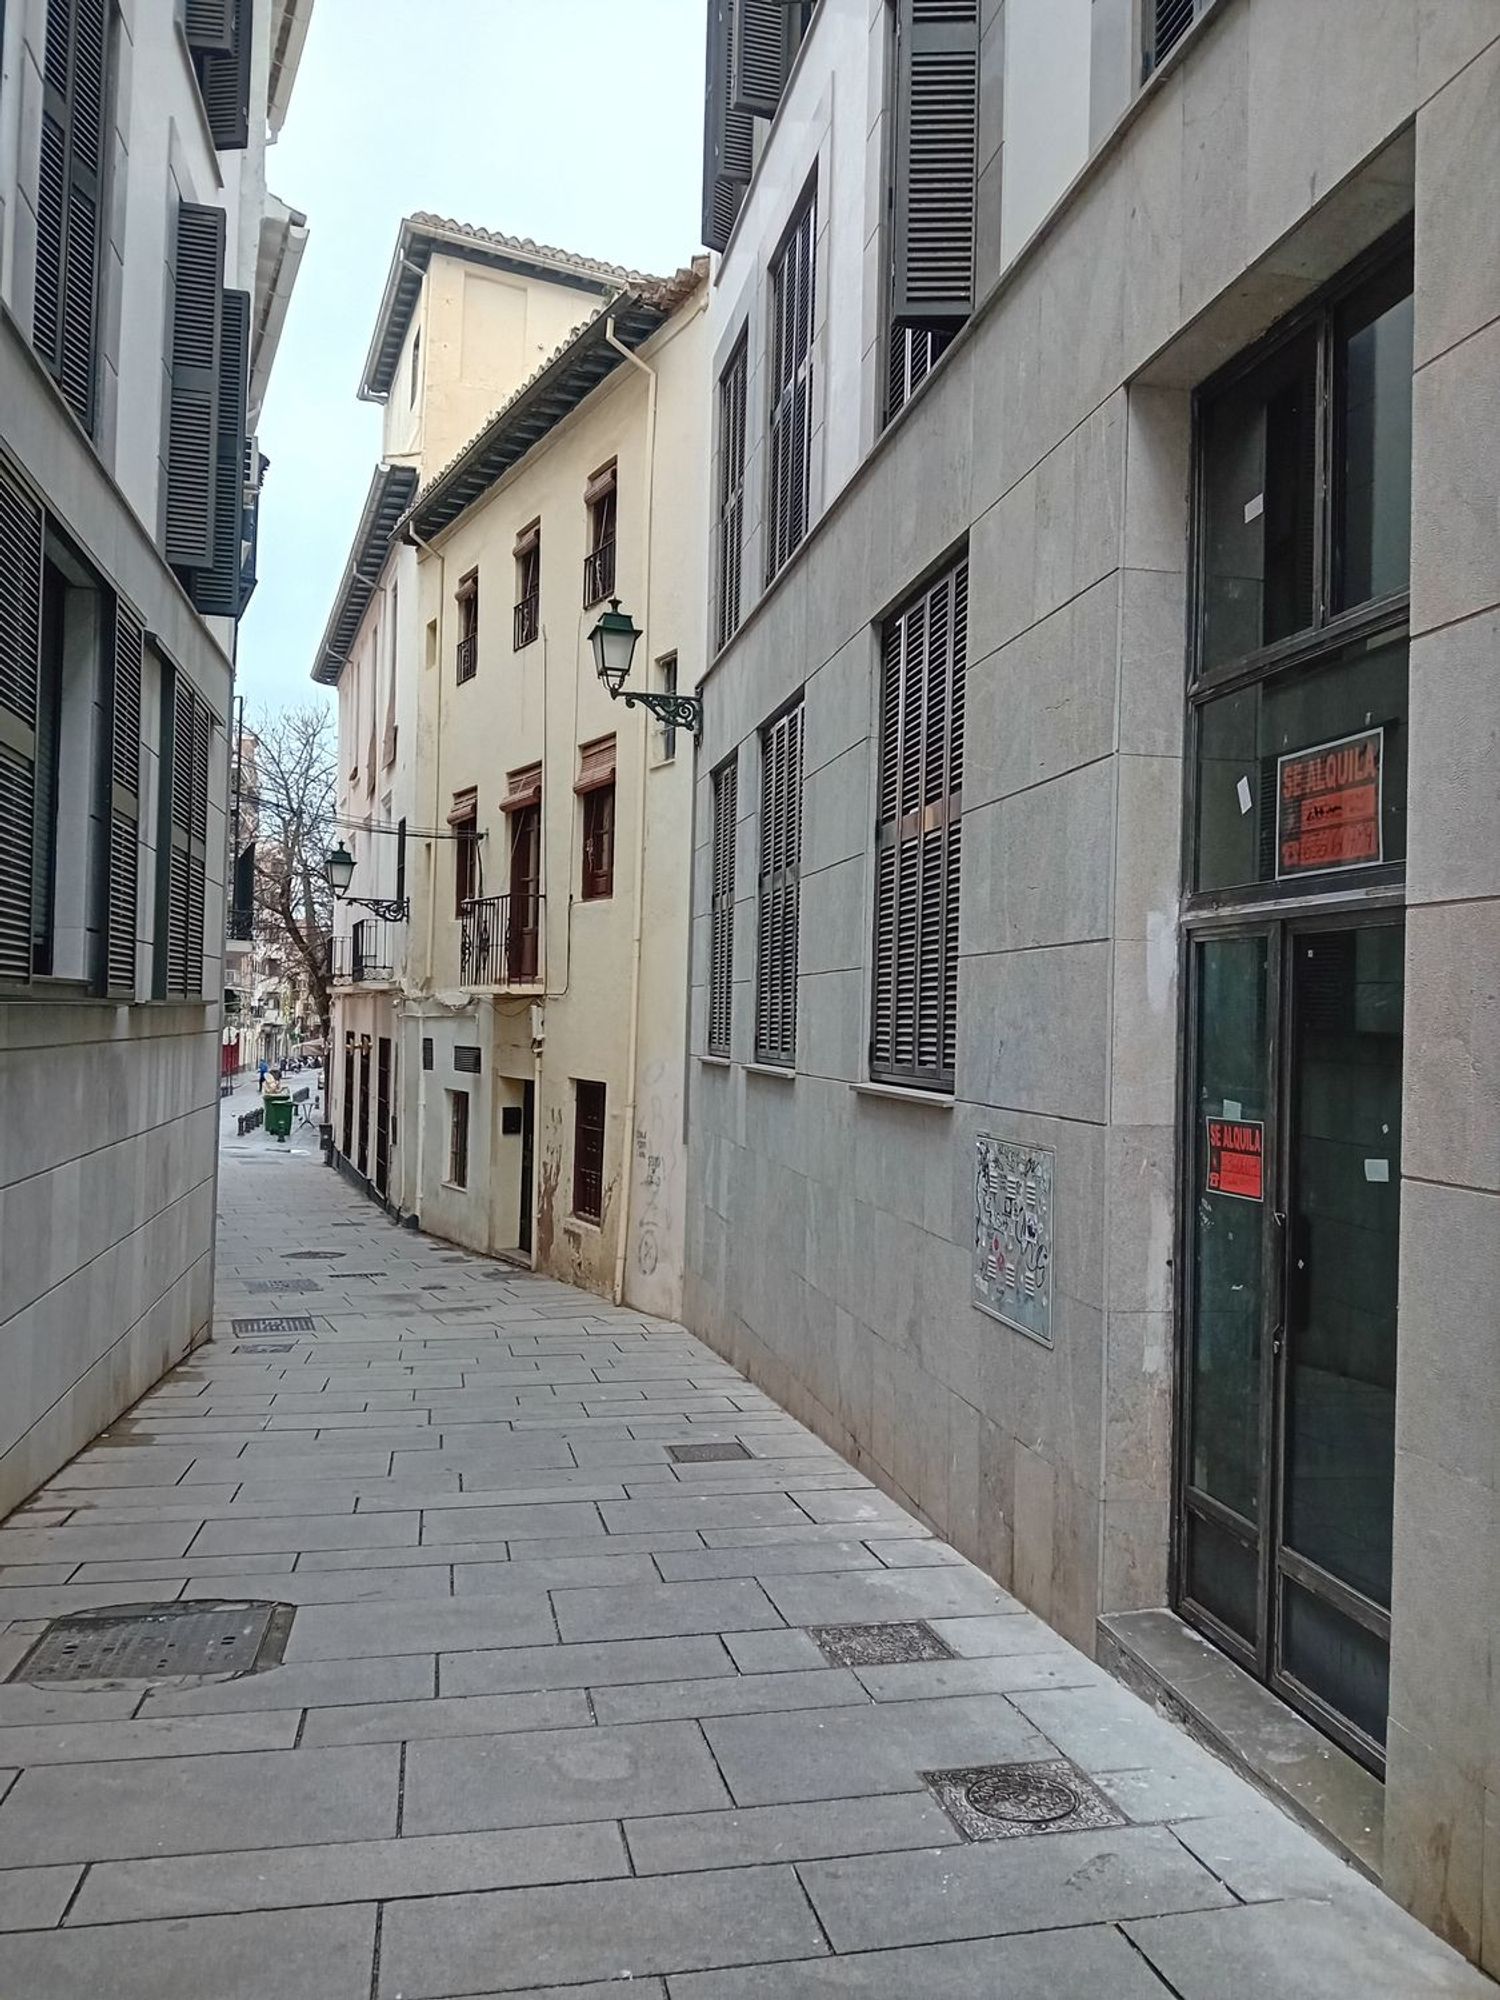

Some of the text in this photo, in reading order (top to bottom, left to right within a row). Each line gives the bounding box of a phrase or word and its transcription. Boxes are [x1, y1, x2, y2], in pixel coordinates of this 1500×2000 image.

[1283, 742, 1377, 798] SE ALQUILA
[1210, 1124, 1261, 1152] SE ALQUILA
